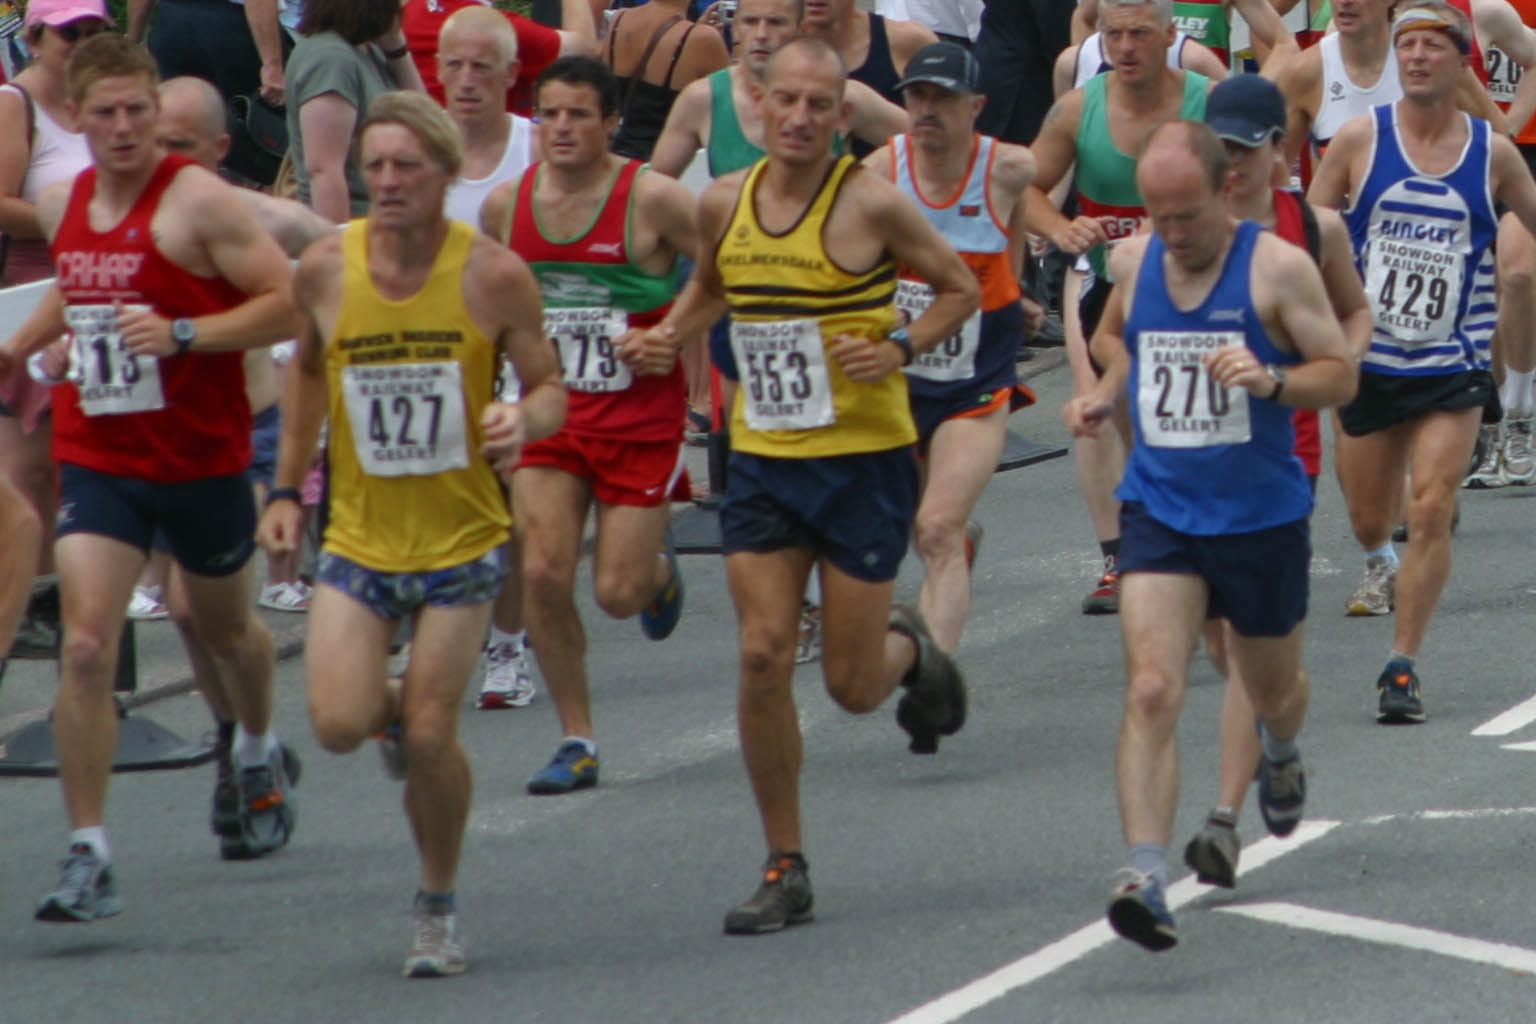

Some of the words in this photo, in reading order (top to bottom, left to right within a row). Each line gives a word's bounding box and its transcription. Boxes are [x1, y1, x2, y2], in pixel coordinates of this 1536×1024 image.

[1488, 50, 1521, 84] 20
[1489, 83, 1517, 93] GELE
[1379, 241, 1454, 265] SNOWDON
[1382, 255, 1447, 277] RAILWAY
[1379, 268, 1448, 321] 429
[545, 310, 612, 321] NOWDON
[1378, 311, 1432, 331] GELERT
[1148, 336, 1229, 349] SNOWDON
[916, 356, 953, 369] LERT
[1153, 351, 1206, 364] RAILW
[746, 352, 811, 403] 553
[1154, 365, 1230, 417] 270
[369, 394, 444, 447] 427
[1159, 419, 1221, 432] GELERT
